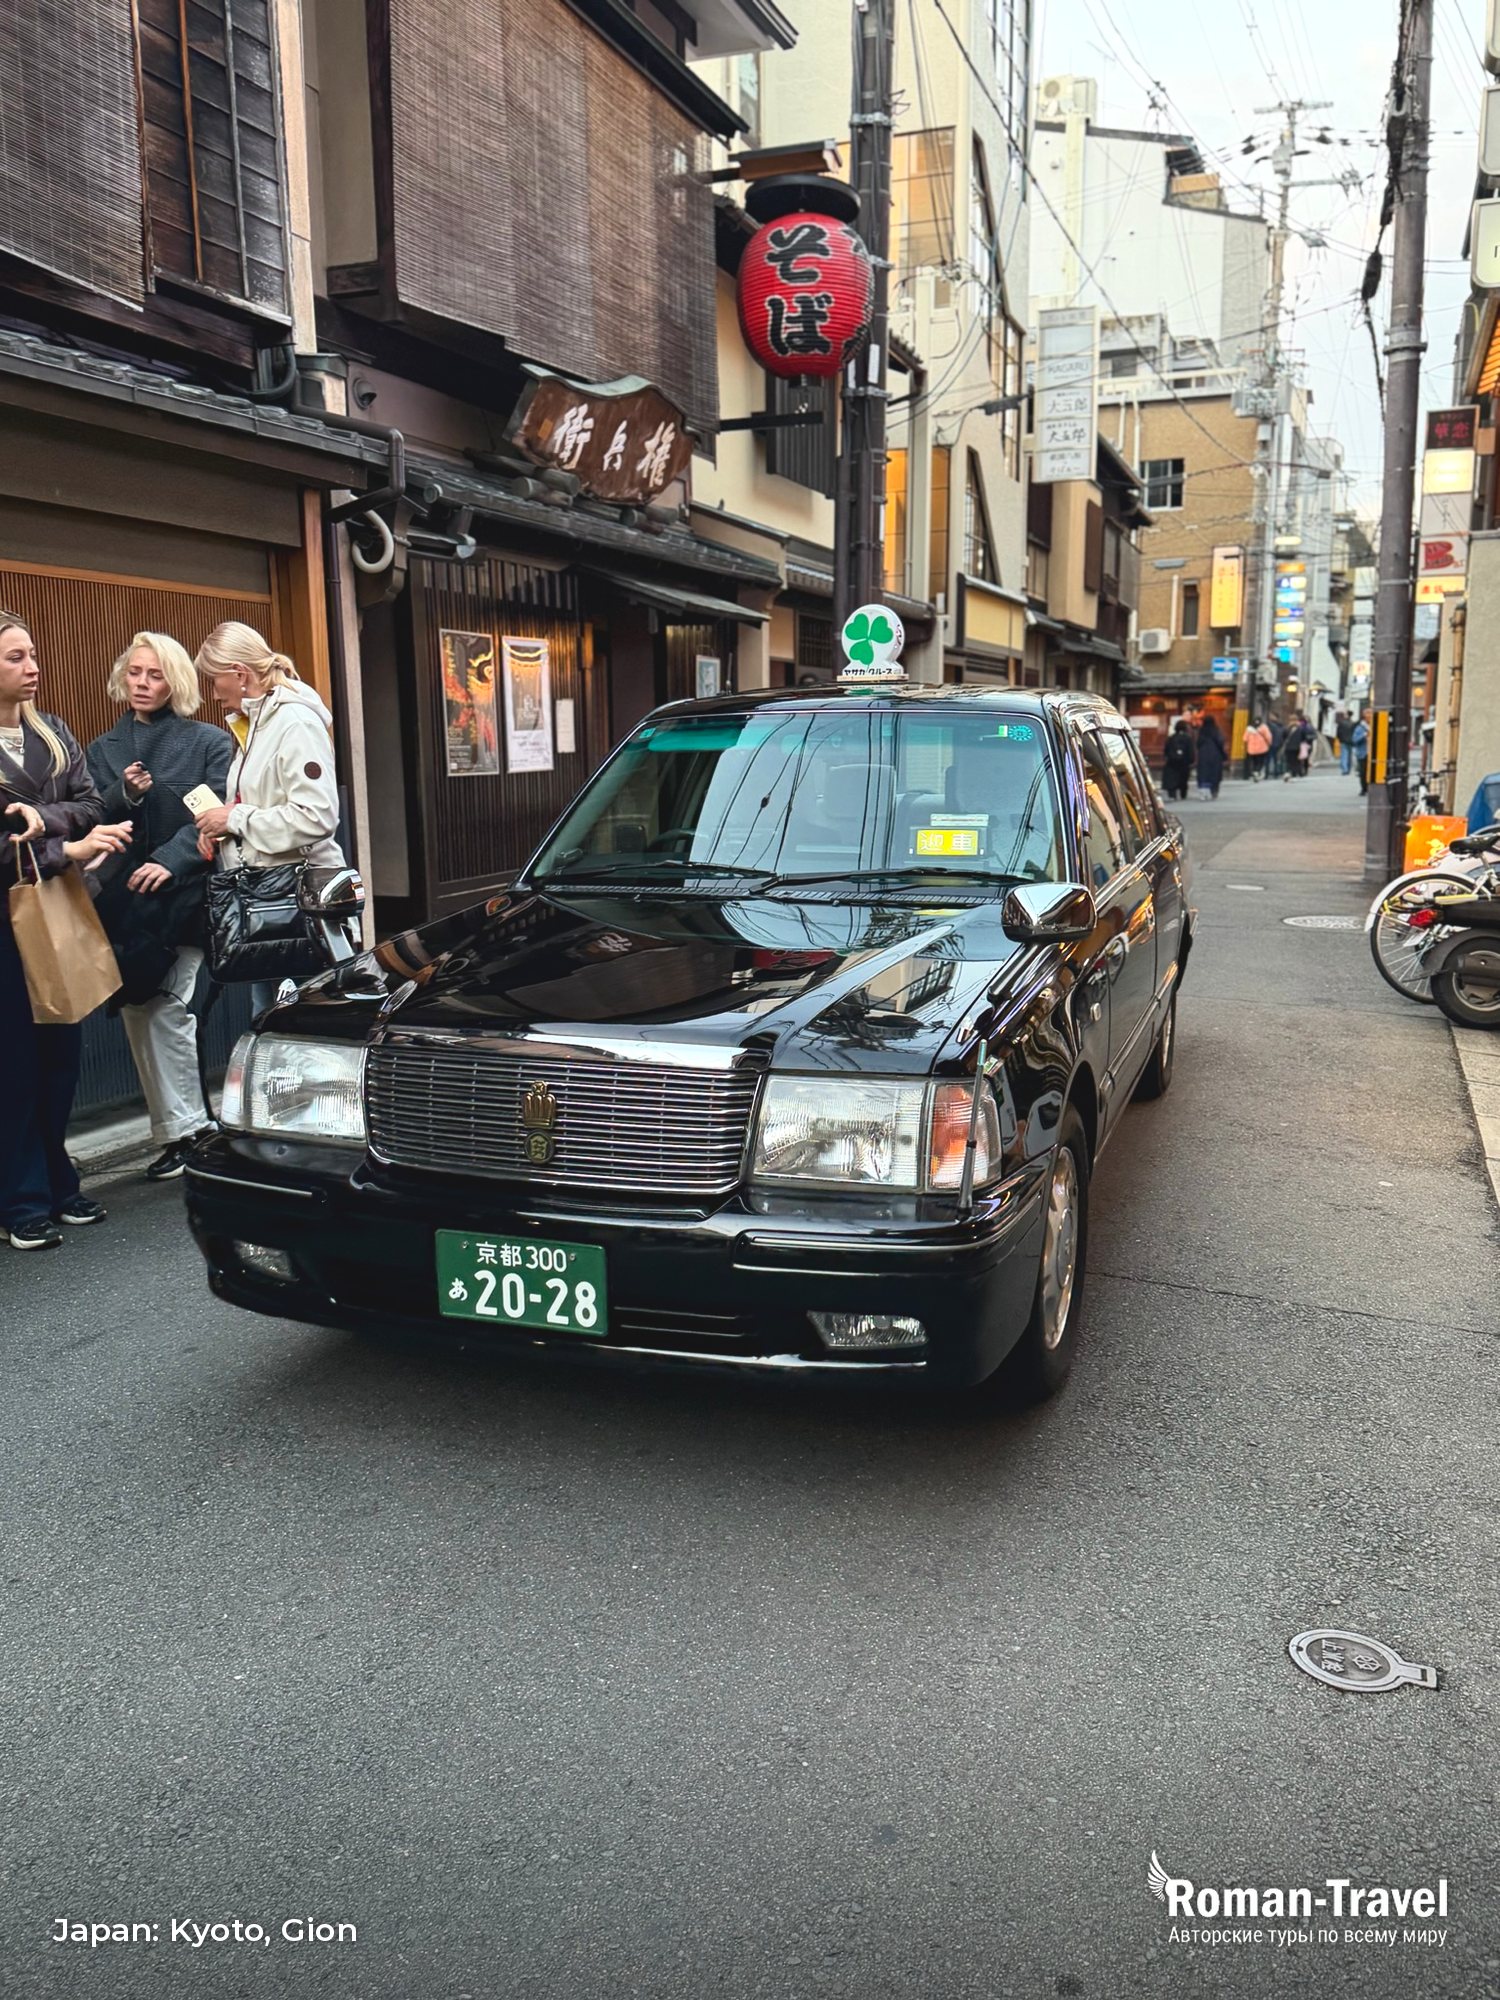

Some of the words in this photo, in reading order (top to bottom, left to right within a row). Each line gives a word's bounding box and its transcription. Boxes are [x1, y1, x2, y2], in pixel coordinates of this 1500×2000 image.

[763, 222, 835, 357] そば
[920, 831, 973, 853] 迎車
[475, 1241, 522, 1267] 京都
[525, 1245, 567, 1273] 300
[448, 1277, 469, 1302] あ
[474, 1269, 599, 1328] 20-28
